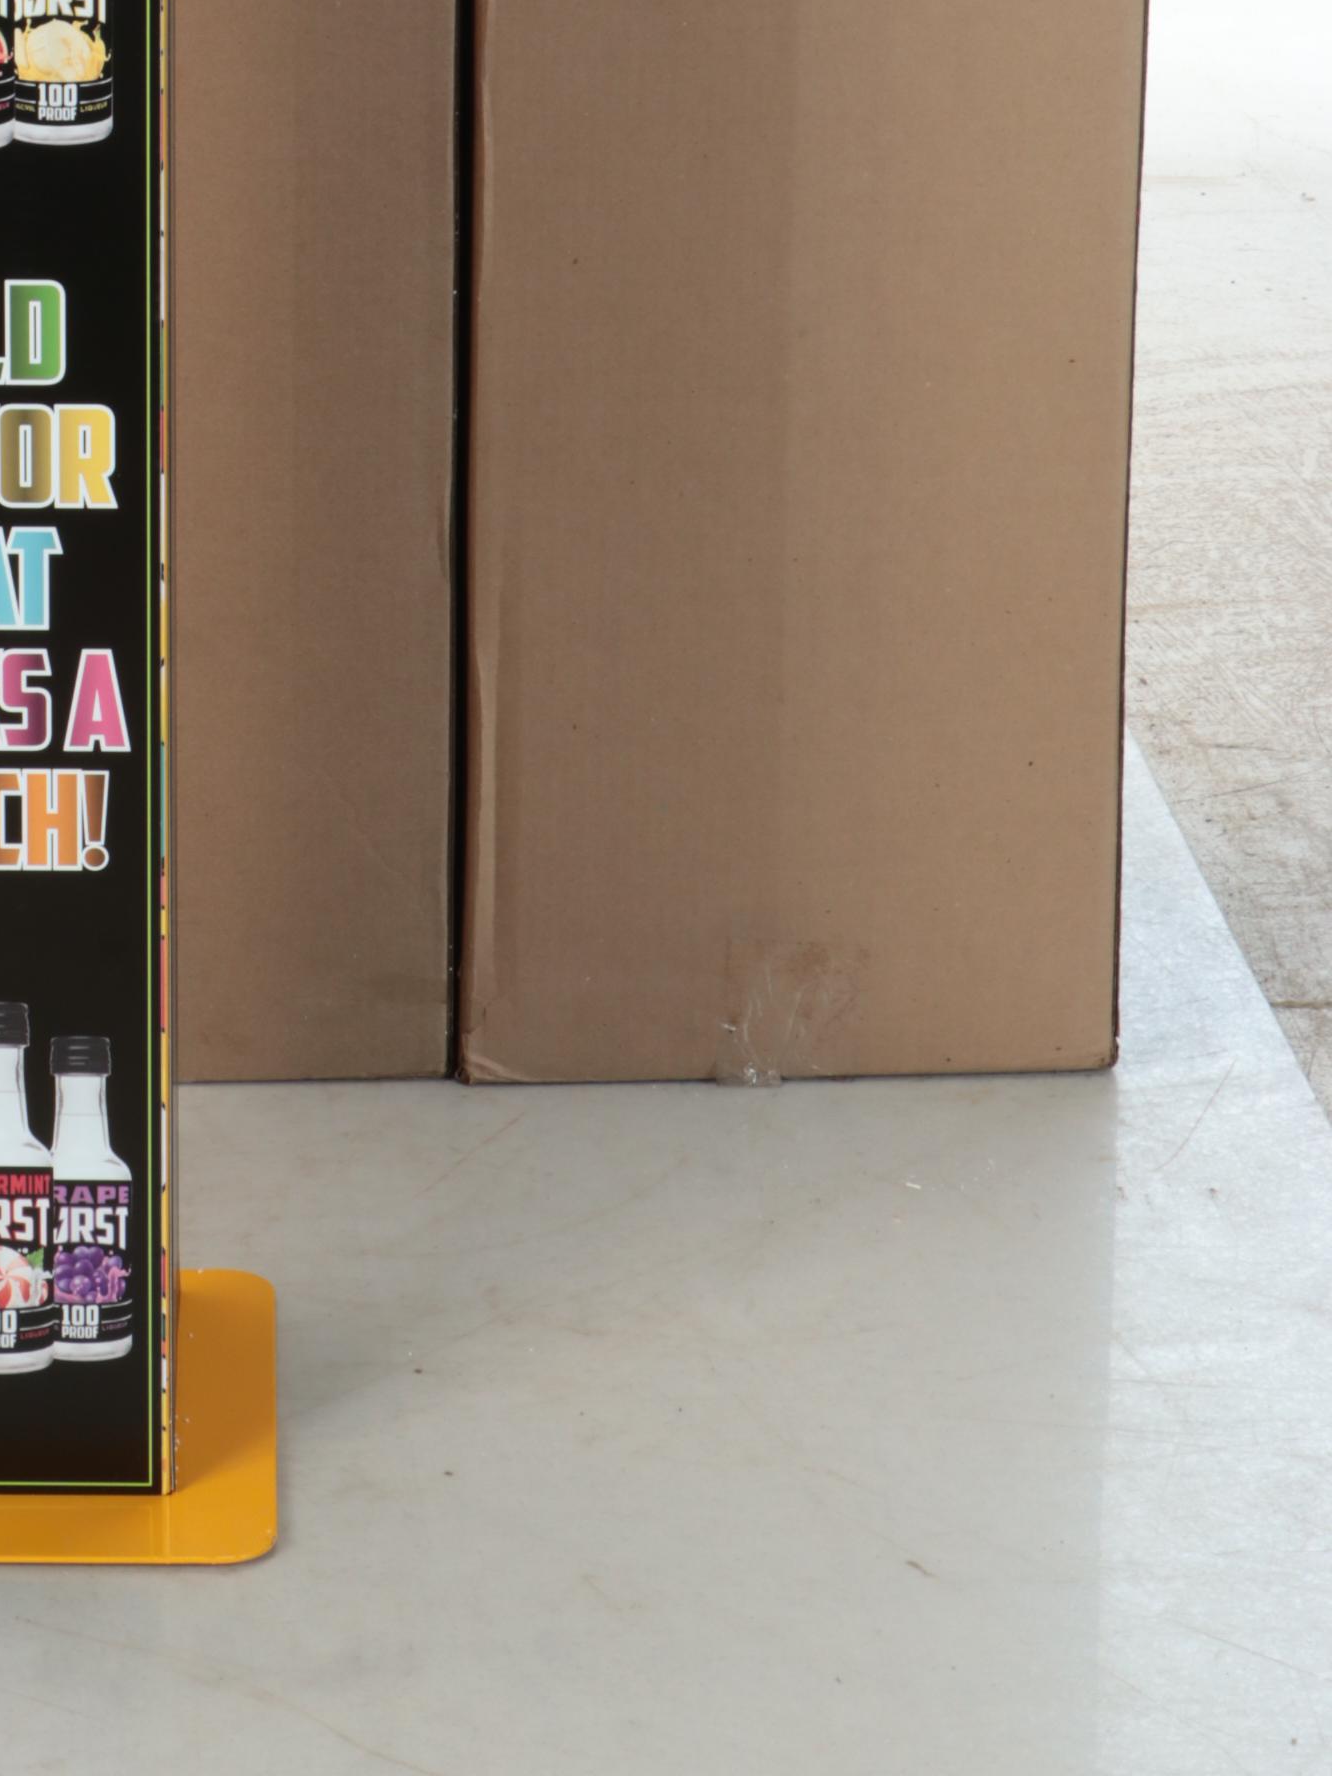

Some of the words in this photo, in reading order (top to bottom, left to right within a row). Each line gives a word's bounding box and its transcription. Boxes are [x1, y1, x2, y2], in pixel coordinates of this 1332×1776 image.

[38, 83, 78, 107] 100
[37, 107, 77, 121] PROOF
[63, 649, 132, 753] A
[53, 1185, 129, 1204] RAPE
[53, 1206, 129, 1250] URST
[61, 1304, 99, 1326] 100
[61, 1326, 99, 1339] PROOF
